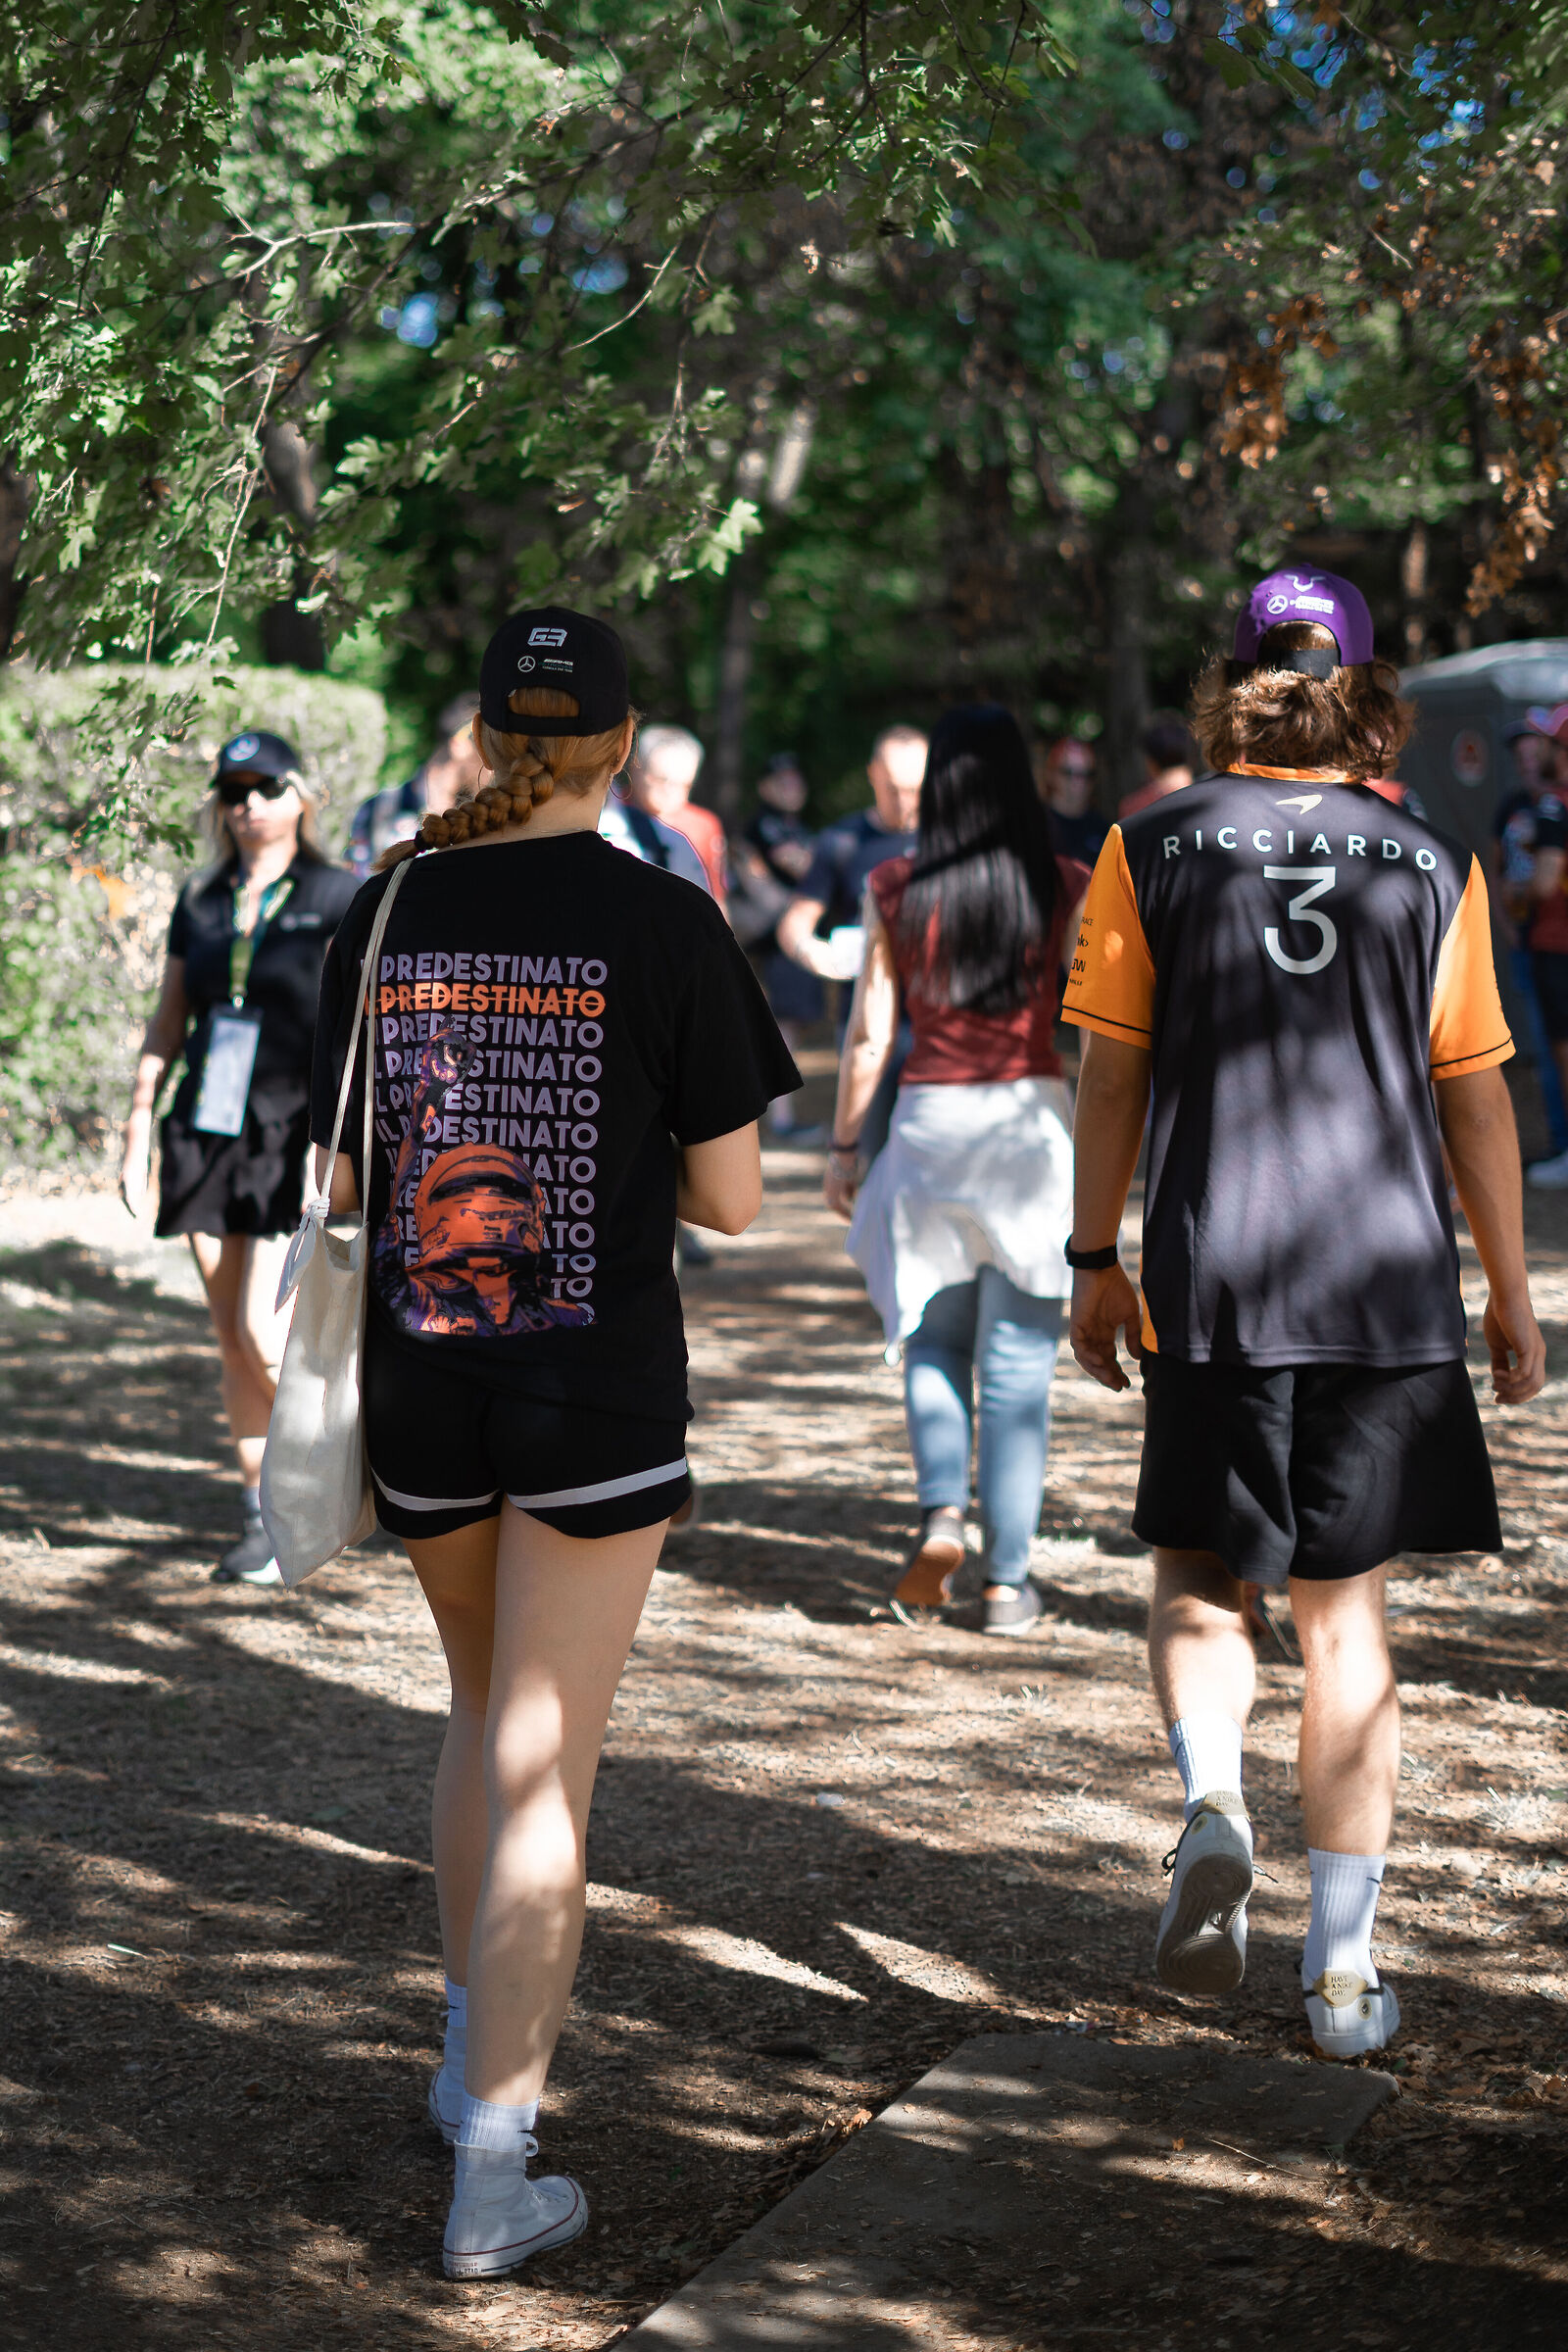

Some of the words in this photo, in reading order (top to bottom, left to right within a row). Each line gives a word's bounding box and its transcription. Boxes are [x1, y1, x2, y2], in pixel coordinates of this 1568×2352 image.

[1163, 826, 1438, 871] RICCIARDO
[1263, 865, 1338, 975] 3
[380, 952, 608, 987] PREDESTINATO
[379, 982, 606, 1018] PREDESTINATO
[385, 1048, 603, 1083] PRESTINATO
[390, 1082, 601, 1117] PRESTINATO
